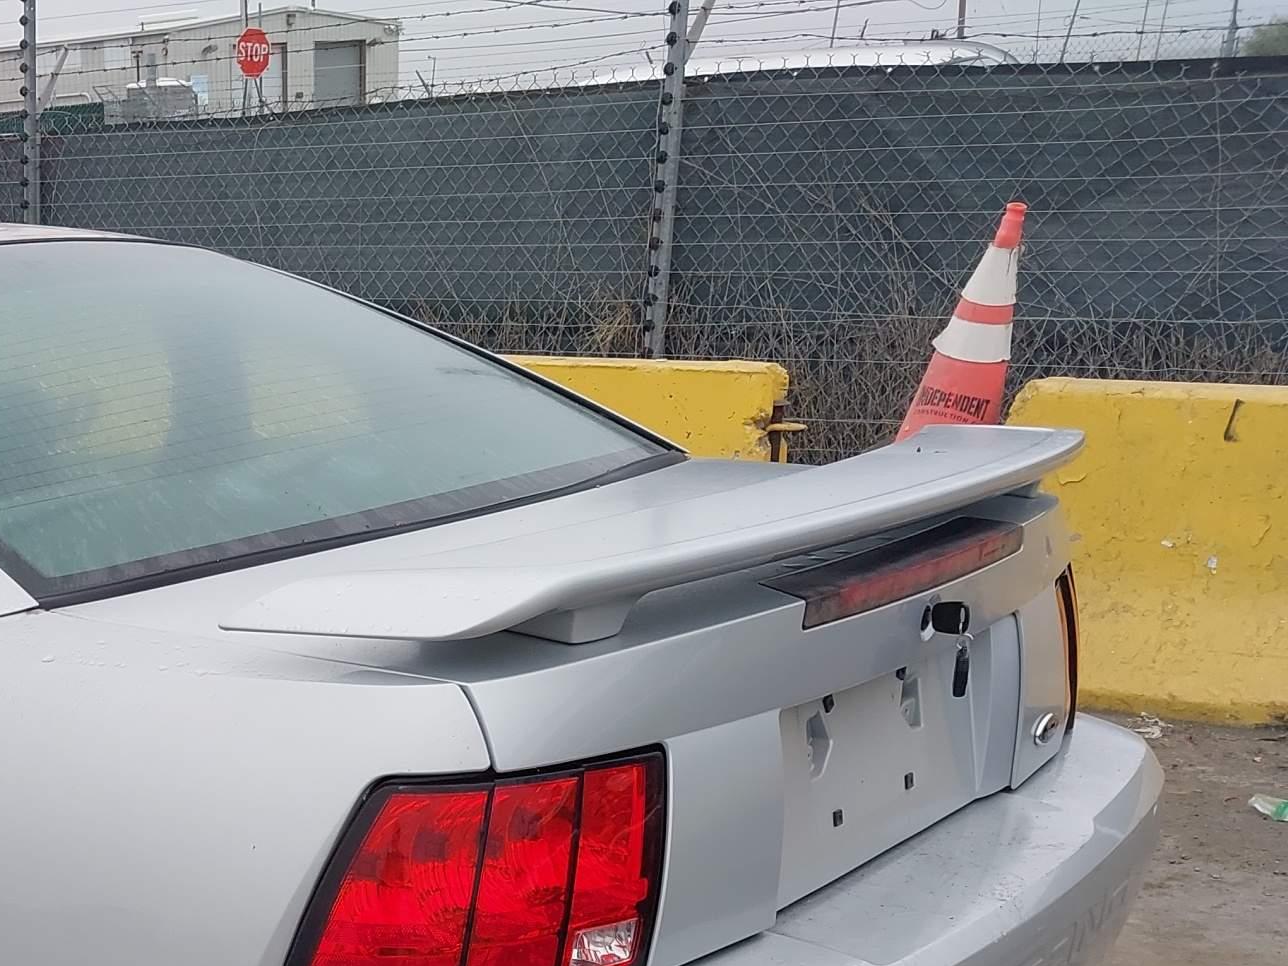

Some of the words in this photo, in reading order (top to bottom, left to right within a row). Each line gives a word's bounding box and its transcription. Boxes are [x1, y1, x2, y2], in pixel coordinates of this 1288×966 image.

[238, 41, 269, 63] STOP
[916, 386, 991, 421] NDEPENDENT
[914, 409, 969, 423] NSTRUCTION
